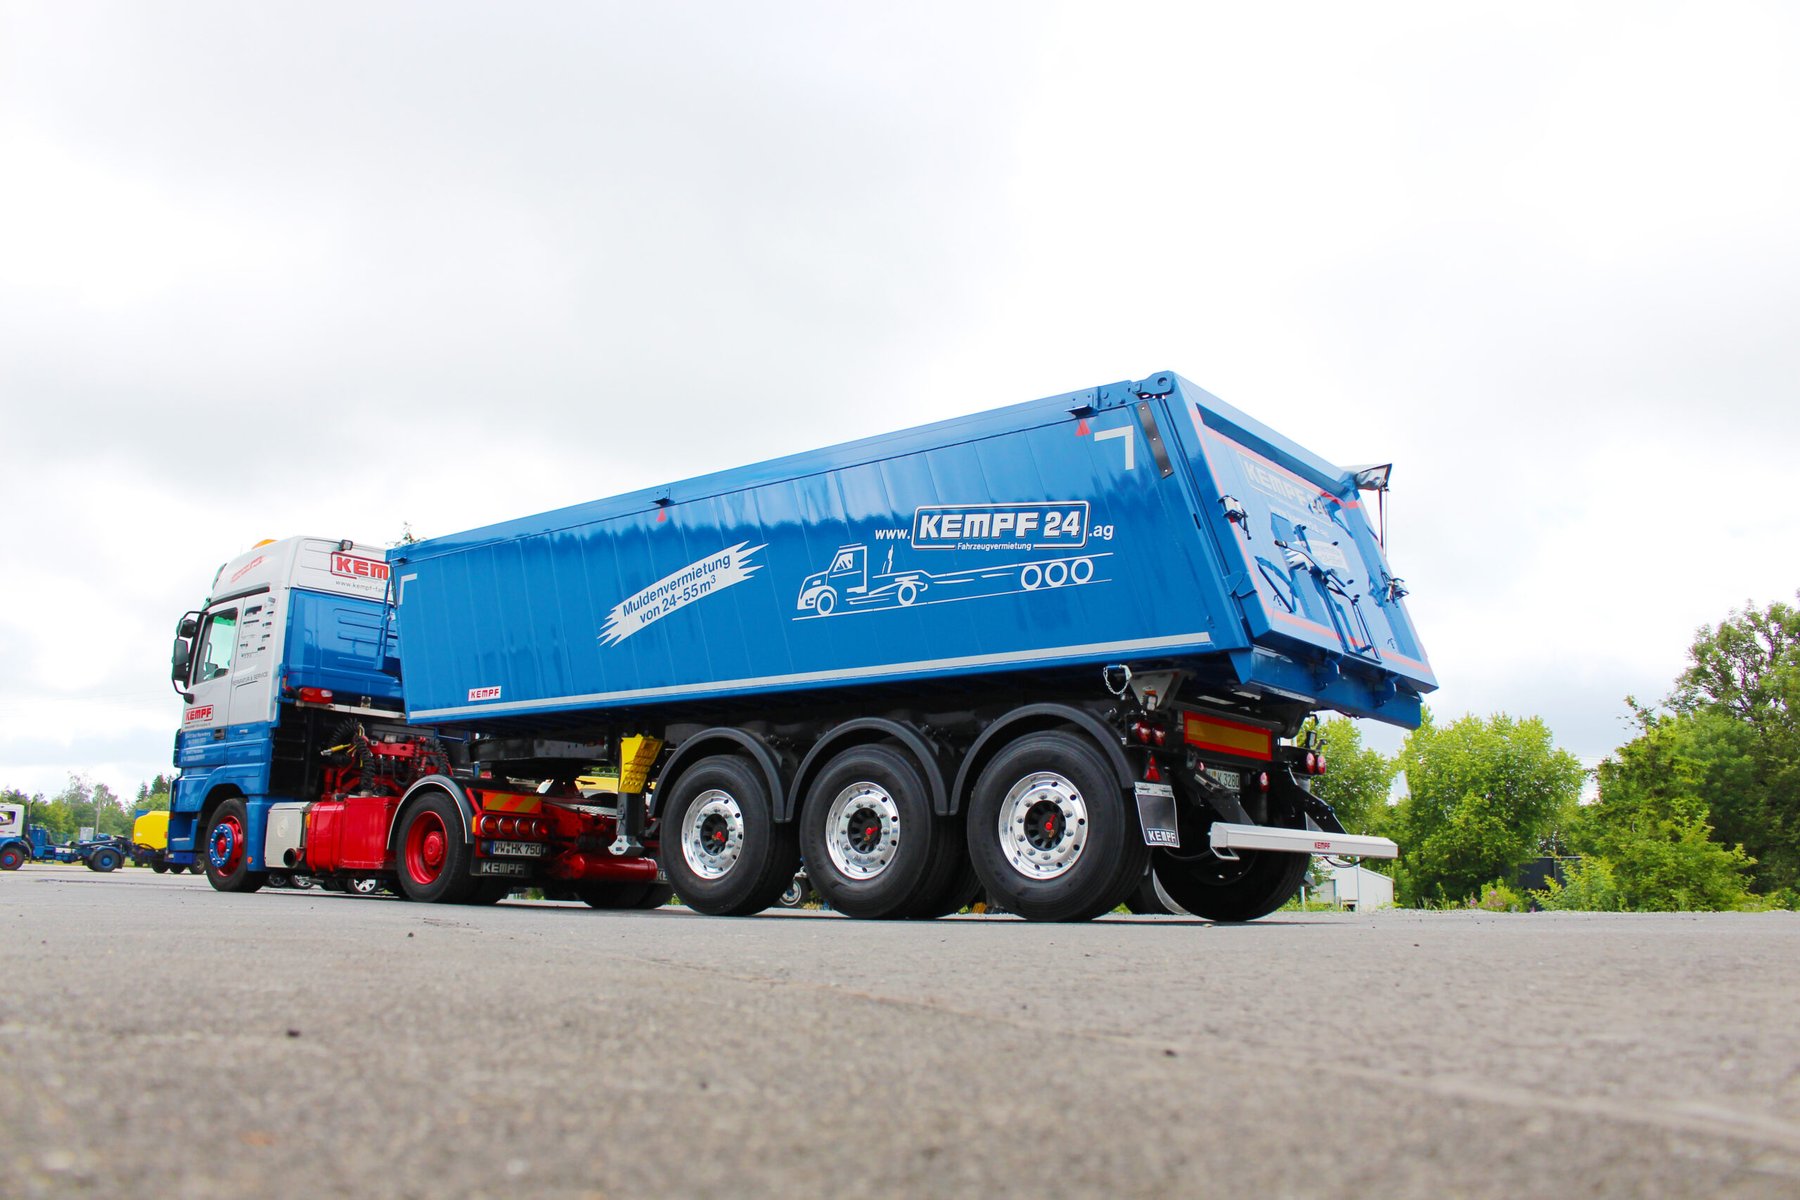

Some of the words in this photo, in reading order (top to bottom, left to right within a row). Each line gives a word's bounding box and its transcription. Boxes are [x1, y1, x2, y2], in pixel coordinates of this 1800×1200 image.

[919, 512, 1040, 539] KEMPF
[1043, 510, 1081, 538] 24
[957, 541, 1032, 551] Fahrzeugvermietung
[622, 554, 731, 617] Muldenvermietung
[639, 607, 661, 623] von
[470, 688, 500, 699] KEMPF
[185, 707, 212, 721] KEMPF
[1148, 830, 1176, 843] KEMPF
[1314, 841, 1331, 850] KEMPF
[482, 862, 526, 875] KEMPF
